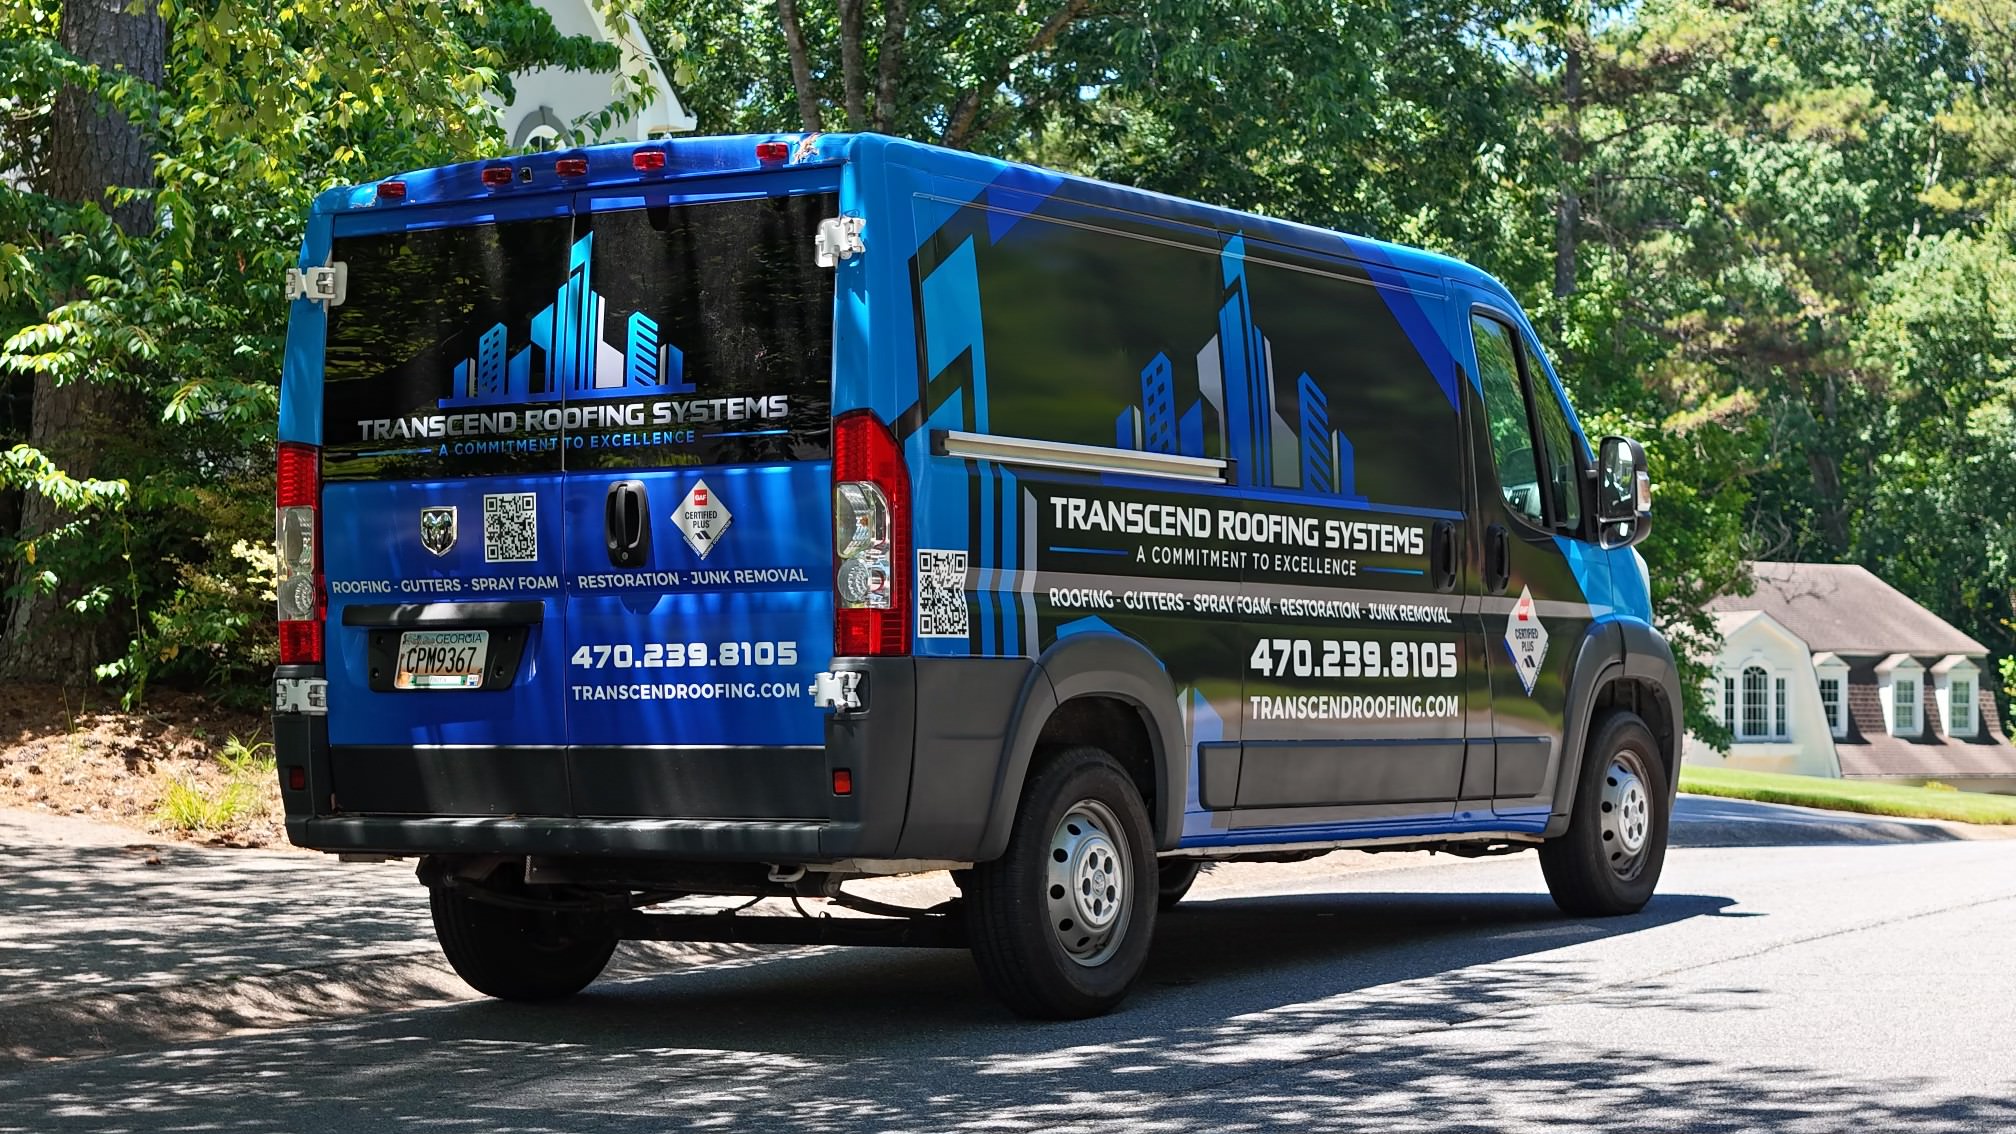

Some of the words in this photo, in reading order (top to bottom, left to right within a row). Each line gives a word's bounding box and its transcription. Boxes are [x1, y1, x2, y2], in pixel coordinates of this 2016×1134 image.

[357, 411, 517, 441] TRANSCEND
[525, 404, 644, 432] ROOFING
[652, 395, 789, 424] SYSTEMS
[438, 444, 449, 456] A
[454, 437, 558, 455] COMMITMENT
[564, 435, 584, 449] TO
[590, 430, 695, 448] EXCELLENCE
[684, 510, 718, 520] CERTIFIED
[692, 520, 710, 529] PLUS
[1050, 496, 1212, 538] TRANSCEND
[1218, 509, 1319, 547] ROOFING
[1325, 519, 1424, 555] SYSTEMS
[1136, 545, 1146, 563] A
[1151, 546, 1247, 569] COMMITMENT
[1252, 553, 1270, 570] TO
[1274, 555, 1357, 576] EXCELLENCE
[332, 580, 391, 594] ROOFING
[401, 578, 461, 592] GUTTERS
[471, 577, 515, 591] SPRAY
[519, 576, 559, 589] FOAM
[578, 572, 680, 589] RESTORATION
[691, 570, 731, 585] JUNK
[734, 568, 809, 584] REMOVAL
[1050, 587, 1114, 609] ROOFING
[1123, 590, 1185, 611] GUTTERS
[1194, 593, 1236, 614] SPRAY
[1236, 595, 1272, 615] FOAM
[1280, 598, 1361, 619] RESTORATION
[1368, 602, 1400, 622] JUNK
[1399, 604, 1452, 624] REMOVAL
[435, 633, 482, 644] GEORGIA
[1514, 628, 1539, 640] CERTIFIED
[1521, 641, 1535, 652] PLUS
[406, 646, 477, 674] CPM9367
[571, 641, 798, 669] 470.239.8105
[1250, 638, 1457, 678] 470.239.8105
[572, 683, 800, 701] TRANSCENDROOFING.COM
[1250, 695, 1459, 720] TRANSCENDROOFING.COM
